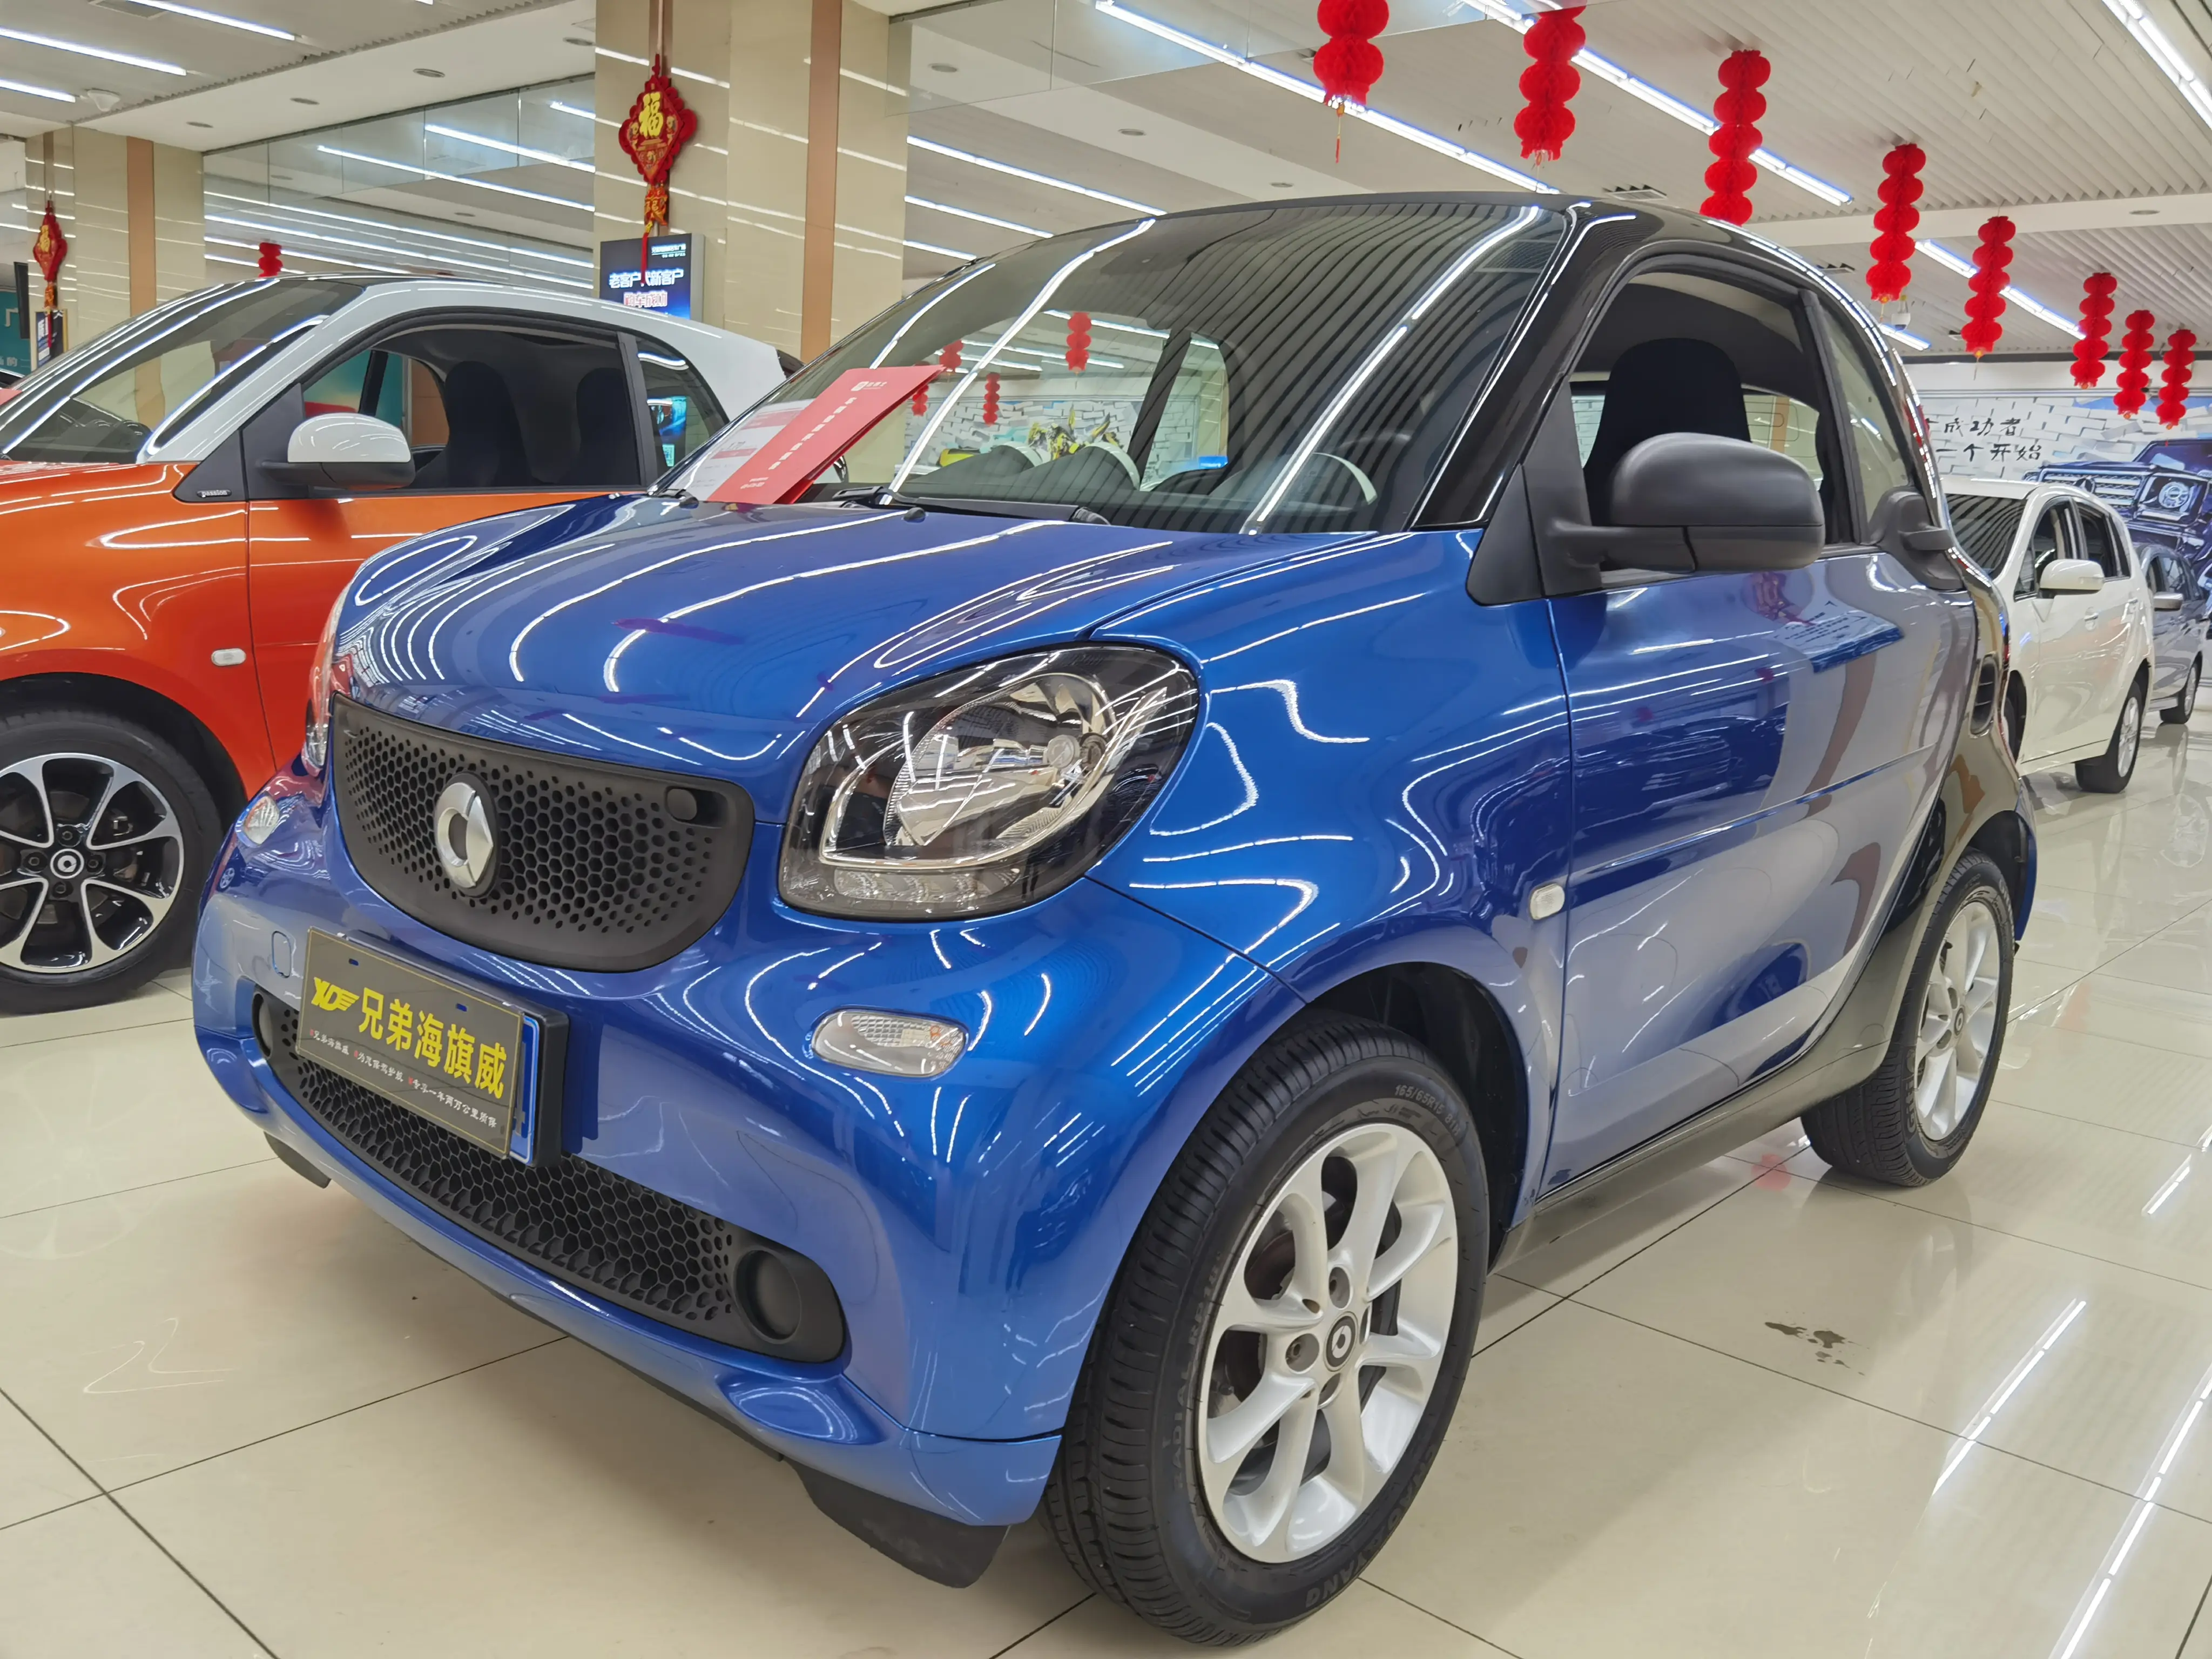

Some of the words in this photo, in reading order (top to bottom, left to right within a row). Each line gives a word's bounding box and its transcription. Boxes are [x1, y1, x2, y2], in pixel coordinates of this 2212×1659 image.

[639, 91, 664, 137] 福
[1936, 443, 2042, 462] 一个开始
[359, 987, 507, 1099] 兄弟海旗威
